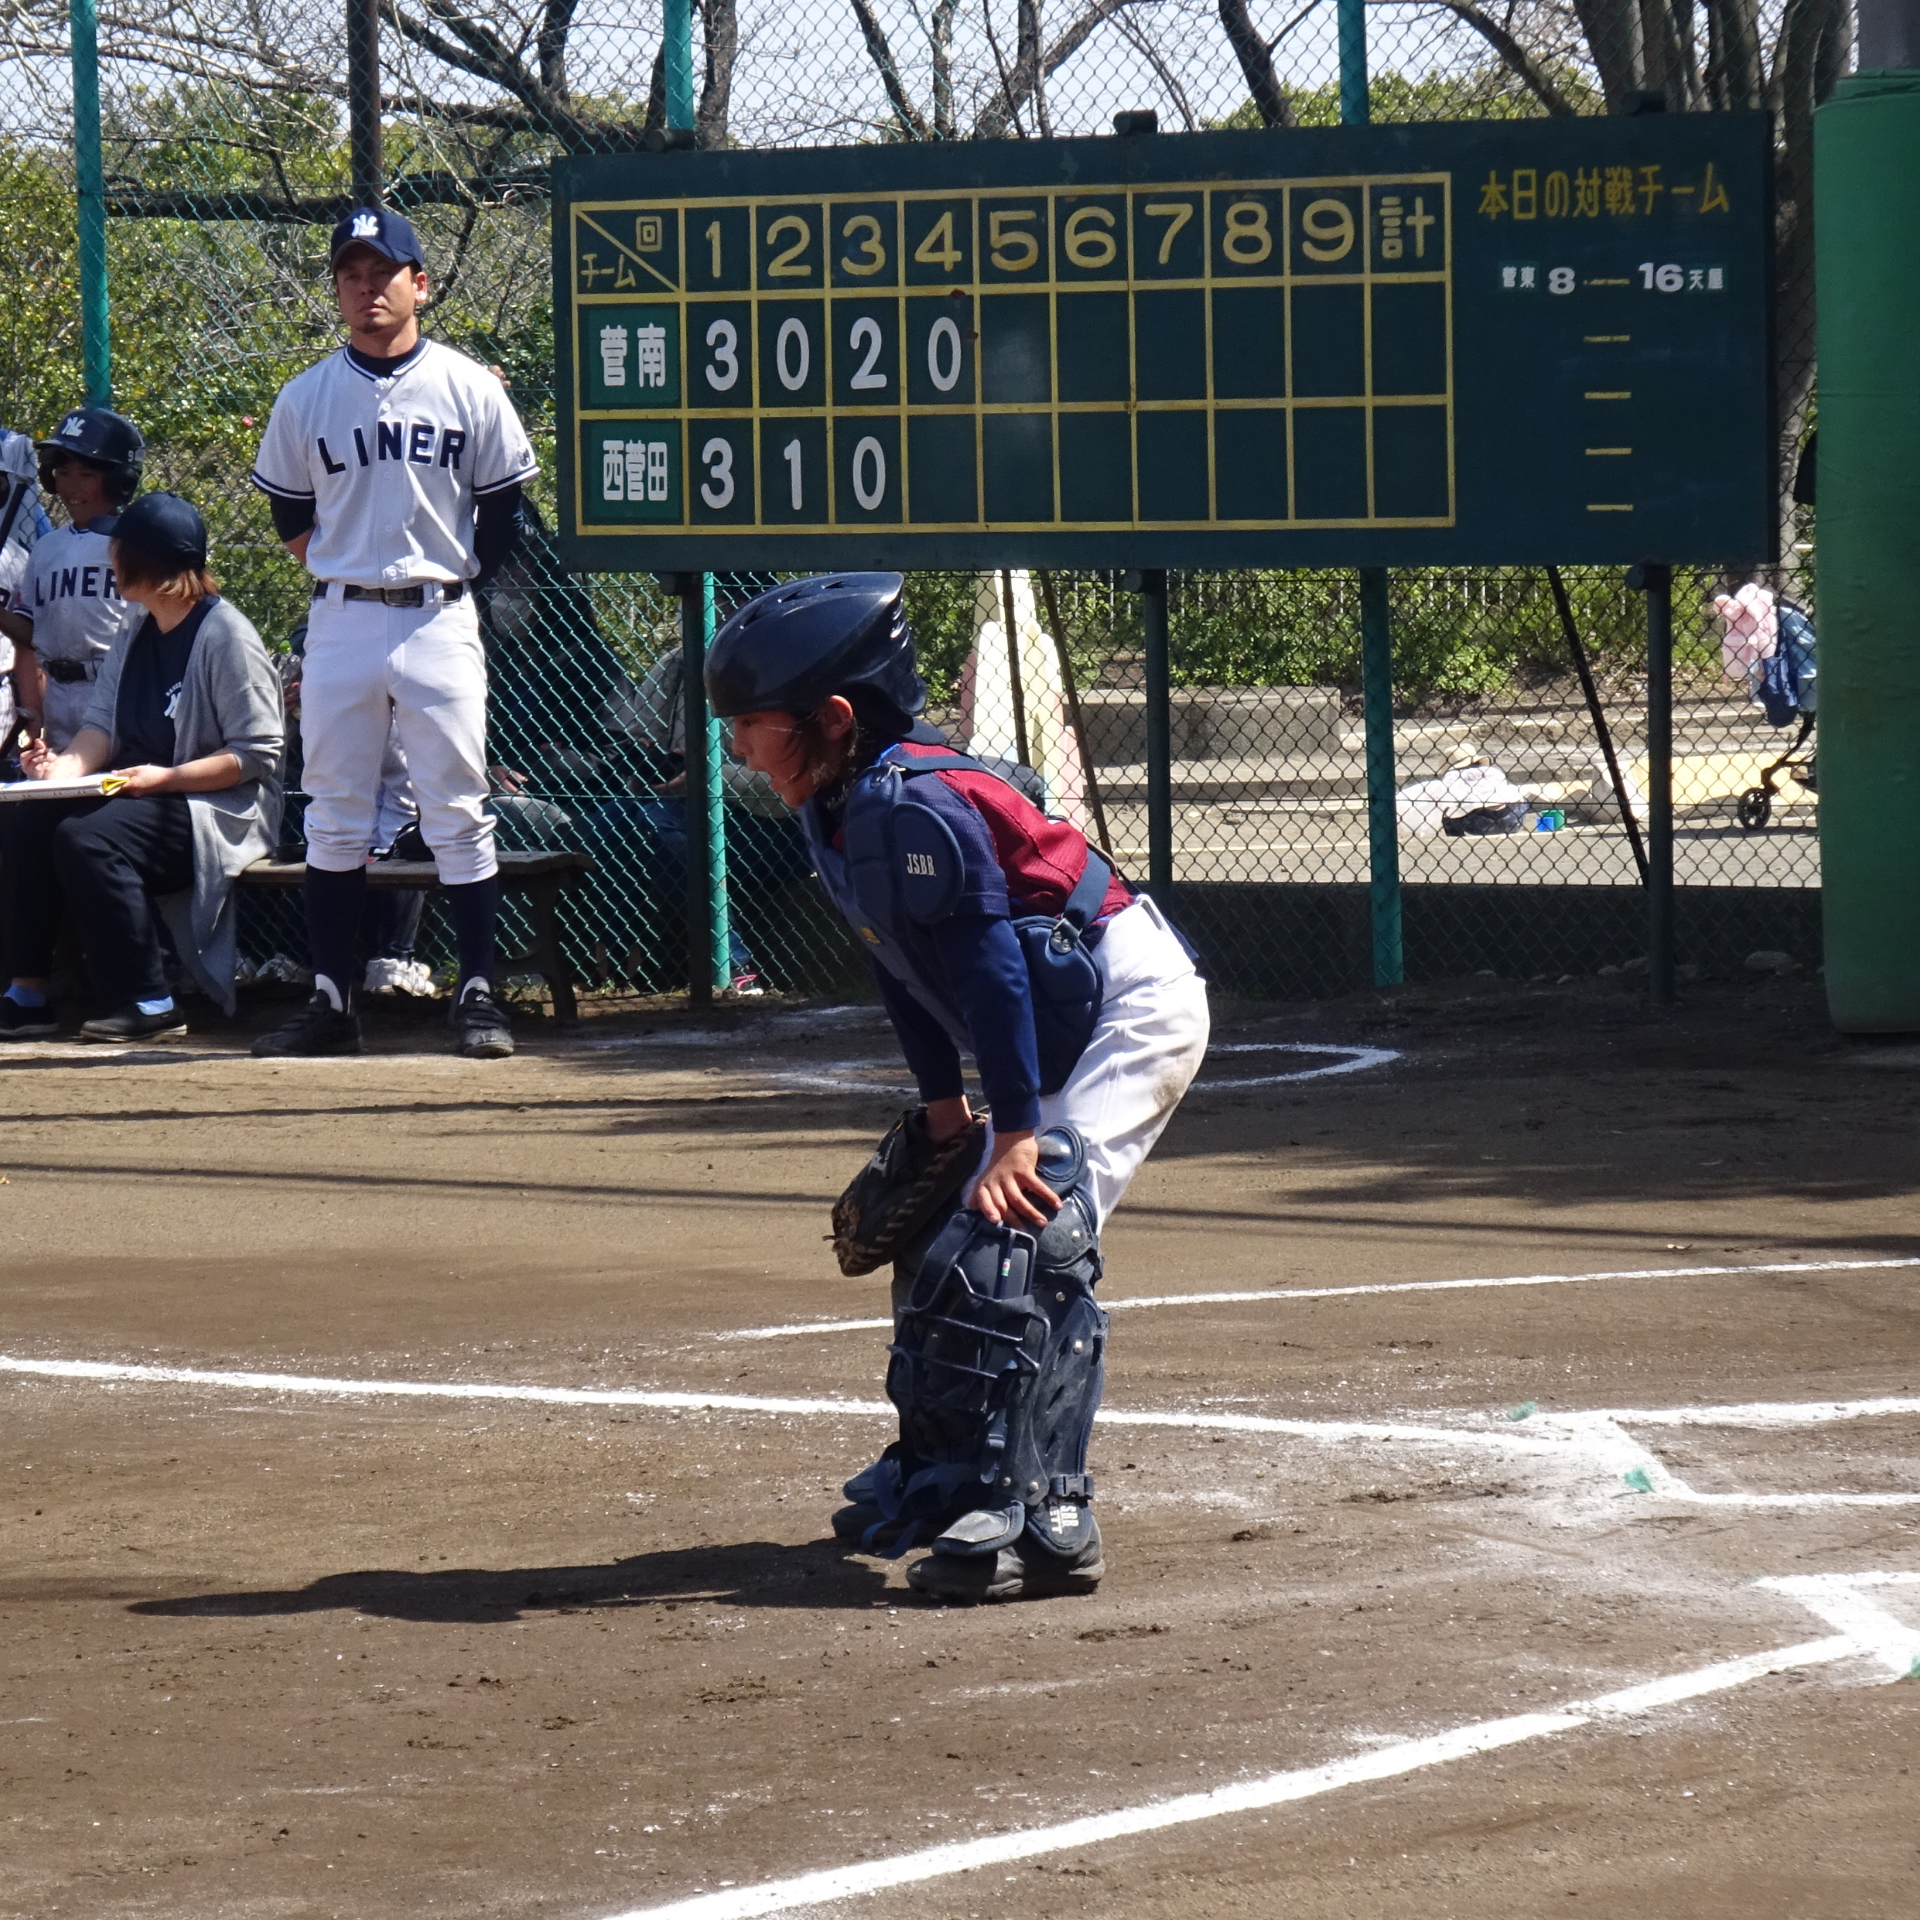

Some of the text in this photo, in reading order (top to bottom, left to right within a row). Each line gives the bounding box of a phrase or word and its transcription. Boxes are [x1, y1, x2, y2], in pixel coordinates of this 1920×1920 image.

[1477, 162, 1729, 220] 本日の対戦チーム
[635, 196, 1436, 278] 回 1 2 3 4 5 6 7 8 9 計
[580, 253, 637, 288] チーム
[1548, 266, 1576, 295] 8
[1638, 262, 1684, 292] 16
[705, 319, 739, 391] 3
[776, 317, 810, 391] 0
[849, 316, 887, 389] 2
[928, 316, 961, 391] 0
[317, 421, 466, 475] LINER
[602, 436, 886, 511] 西菅田 3 1 0
[35, 566, 121, 607] LINER
